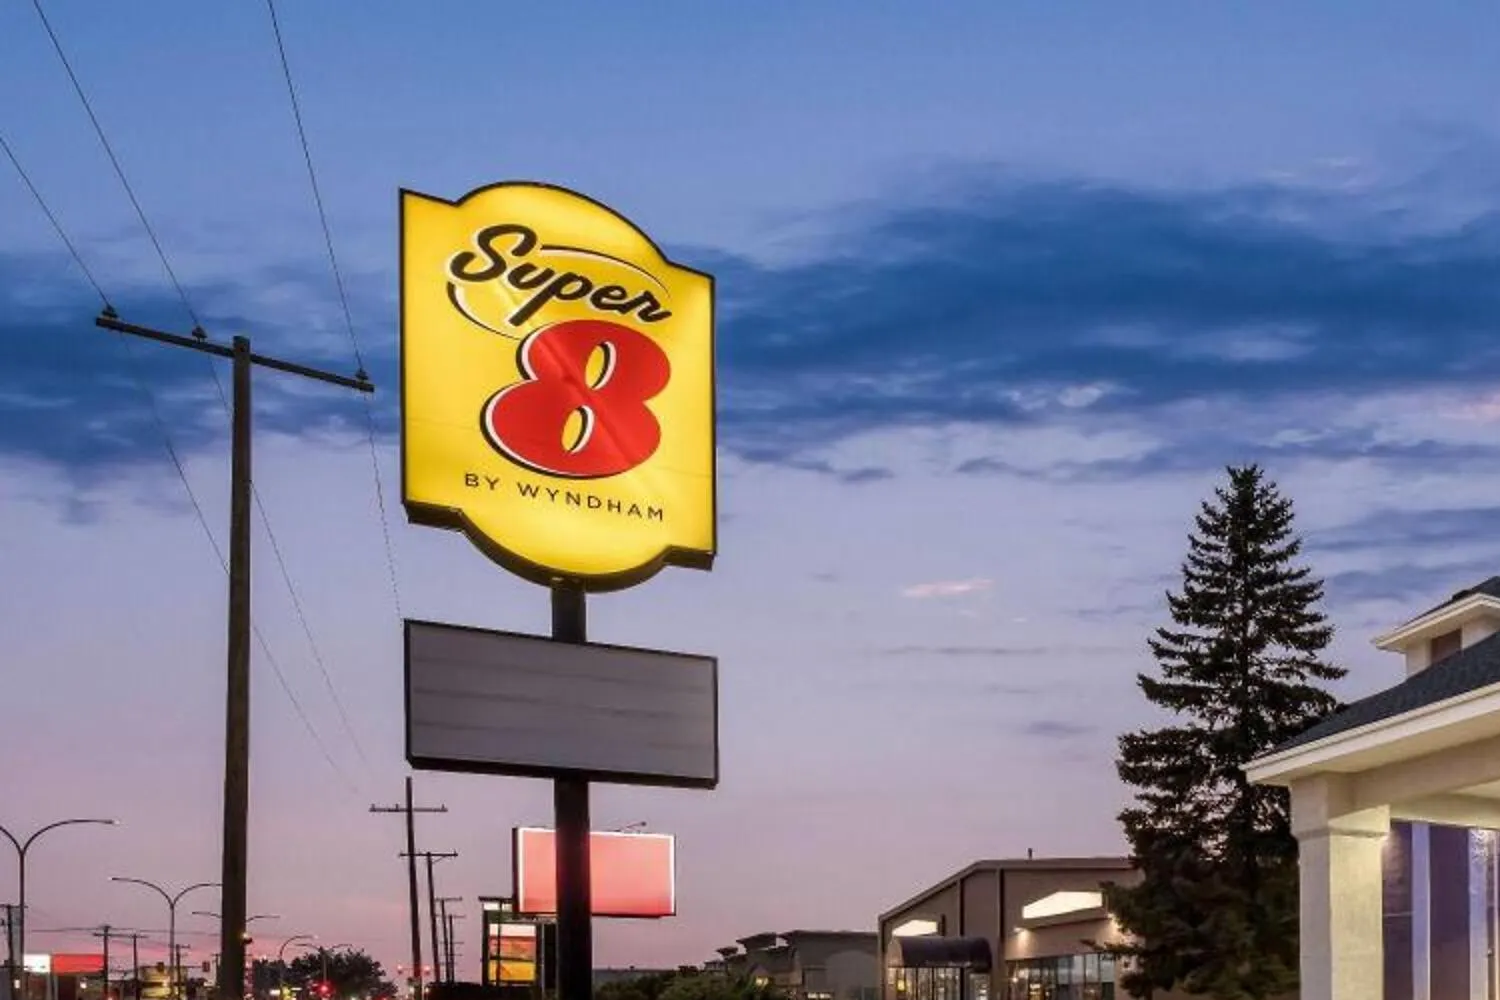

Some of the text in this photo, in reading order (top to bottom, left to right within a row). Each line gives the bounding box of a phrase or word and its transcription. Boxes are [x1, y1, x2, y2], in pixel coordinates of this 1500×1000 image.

[449, 223, 672, 328] Super
[479, 319, 672, 481] 8
[464, 472, 664, 522] BY WYNDHAM
